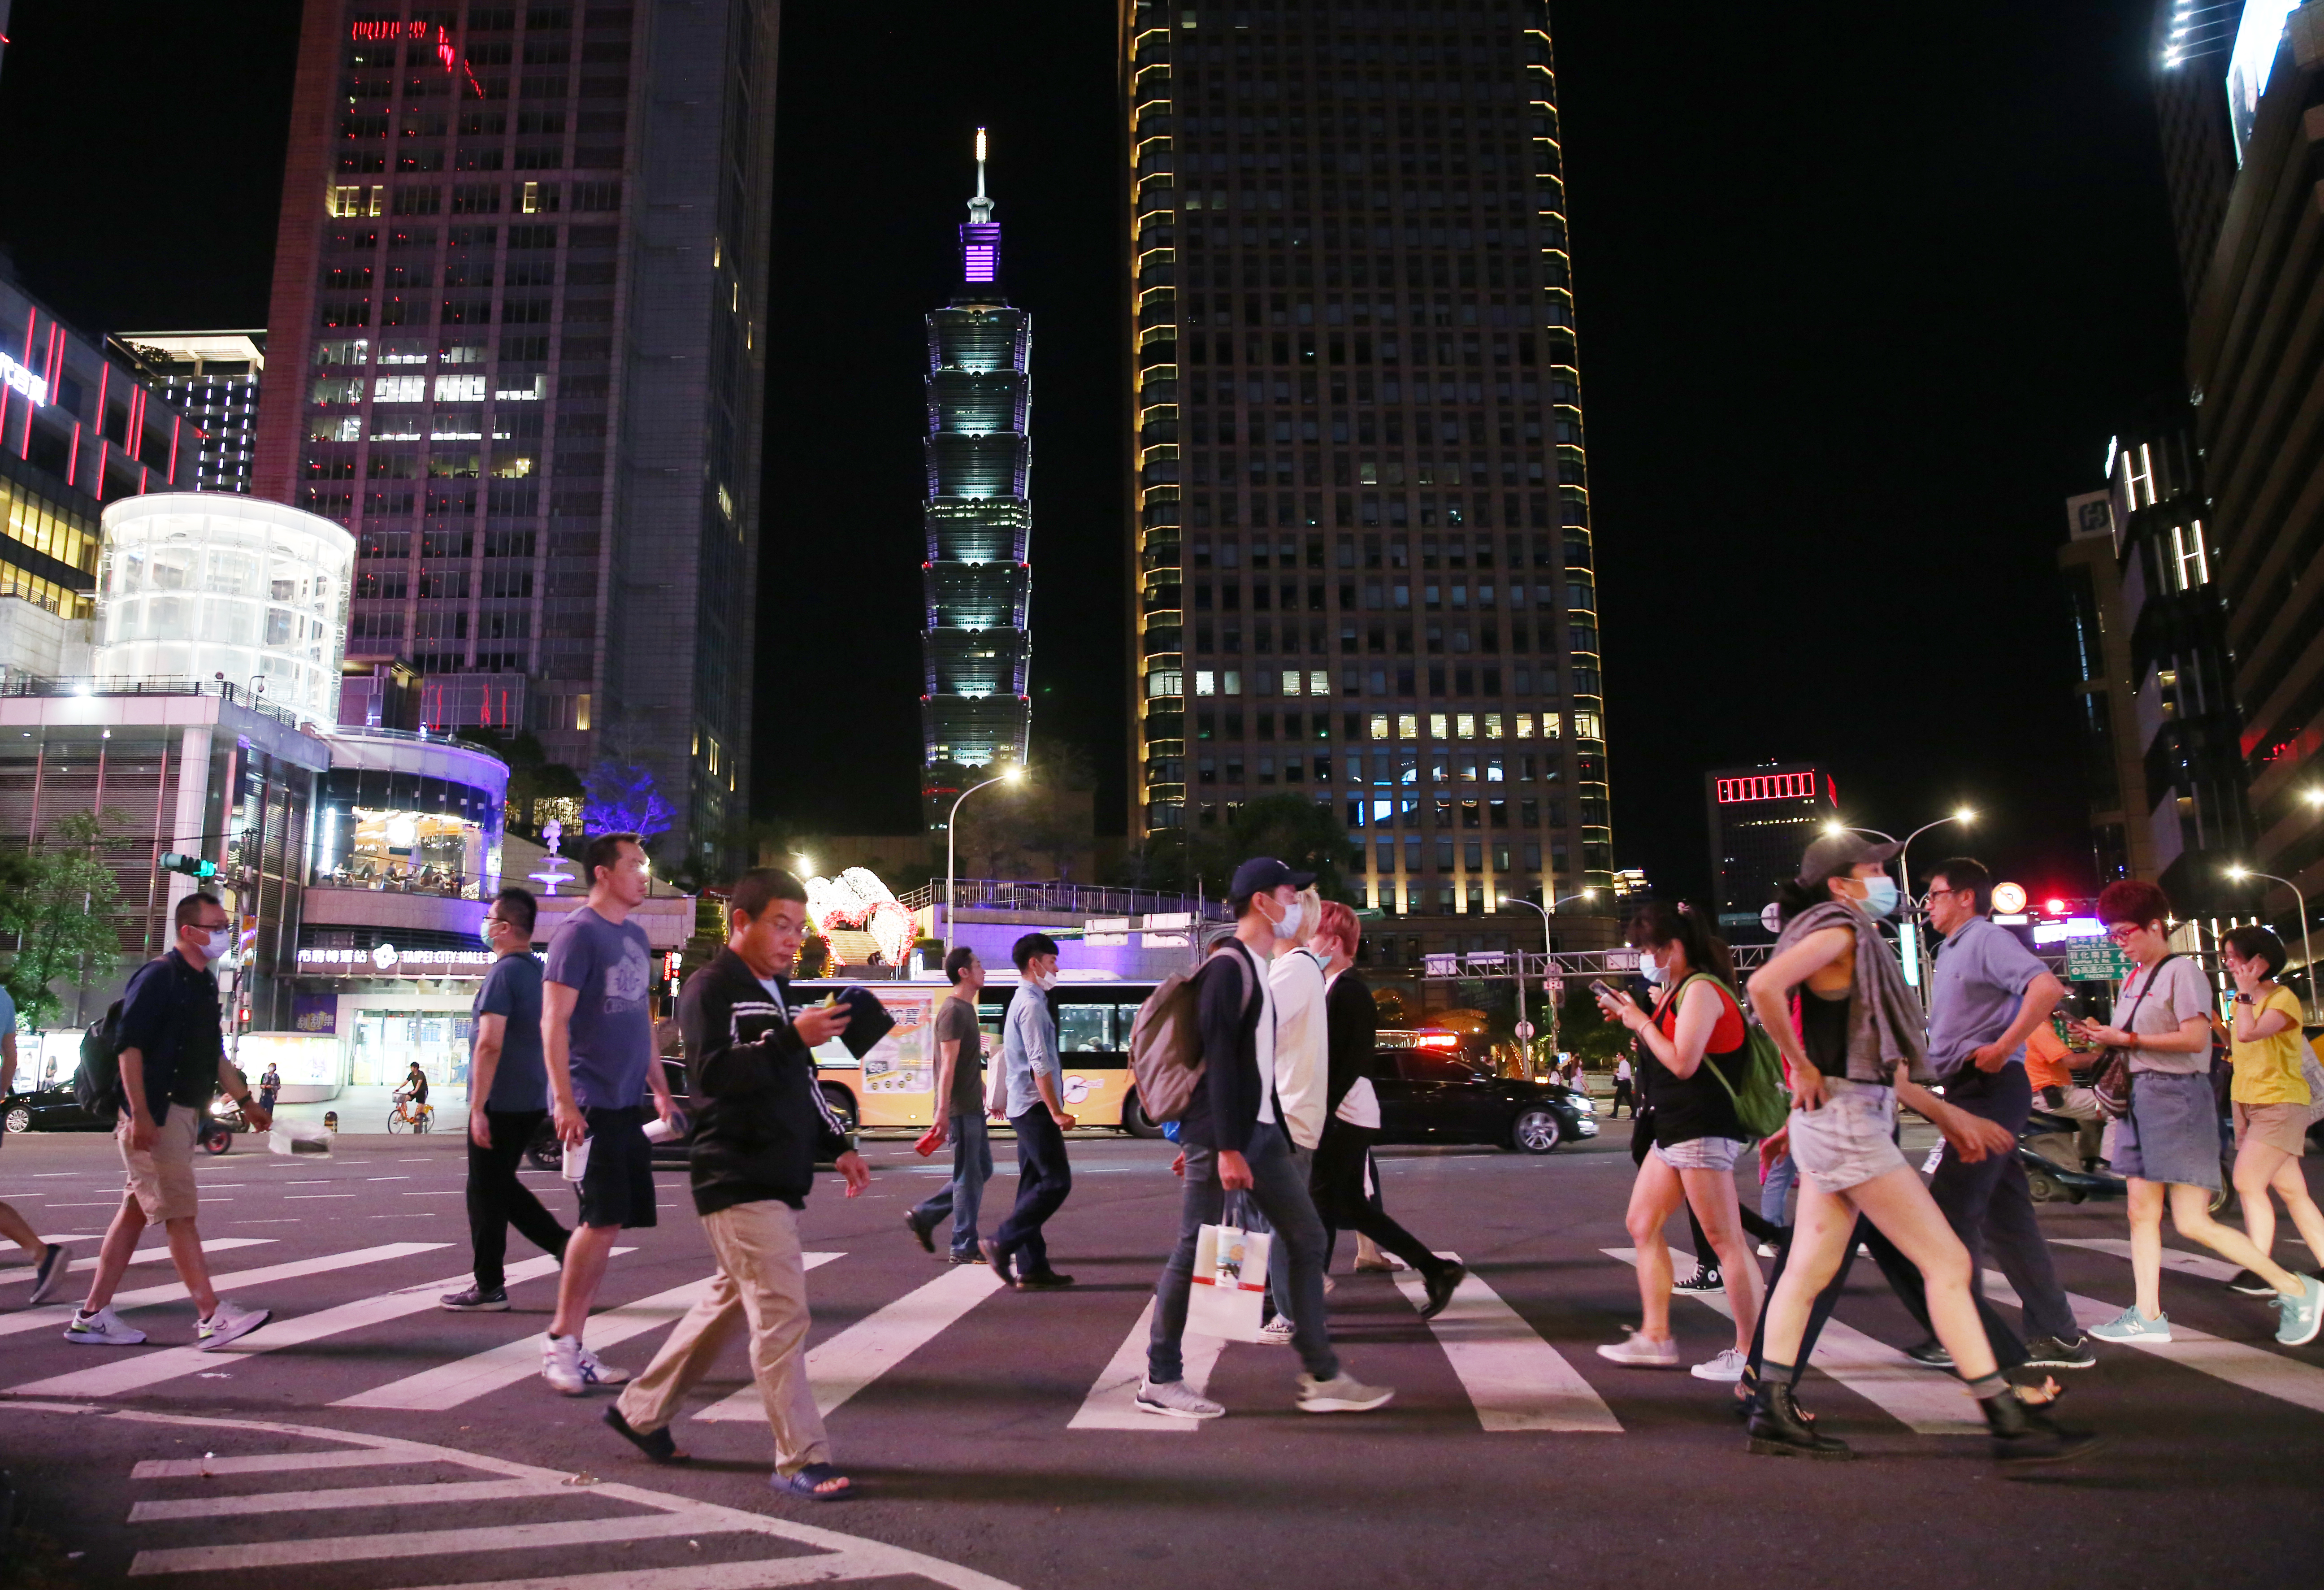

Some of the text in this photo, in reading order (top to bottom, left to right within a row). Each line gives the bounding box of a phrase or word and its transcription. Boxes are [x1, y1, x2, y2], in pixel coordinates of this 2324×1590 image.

[402, 951, 433, 964] TAIPEI
[435, 951, 457, 964] CITY
[459, 951, 486, 964] HALL
[1559, 1053, 1568, 1064] P
